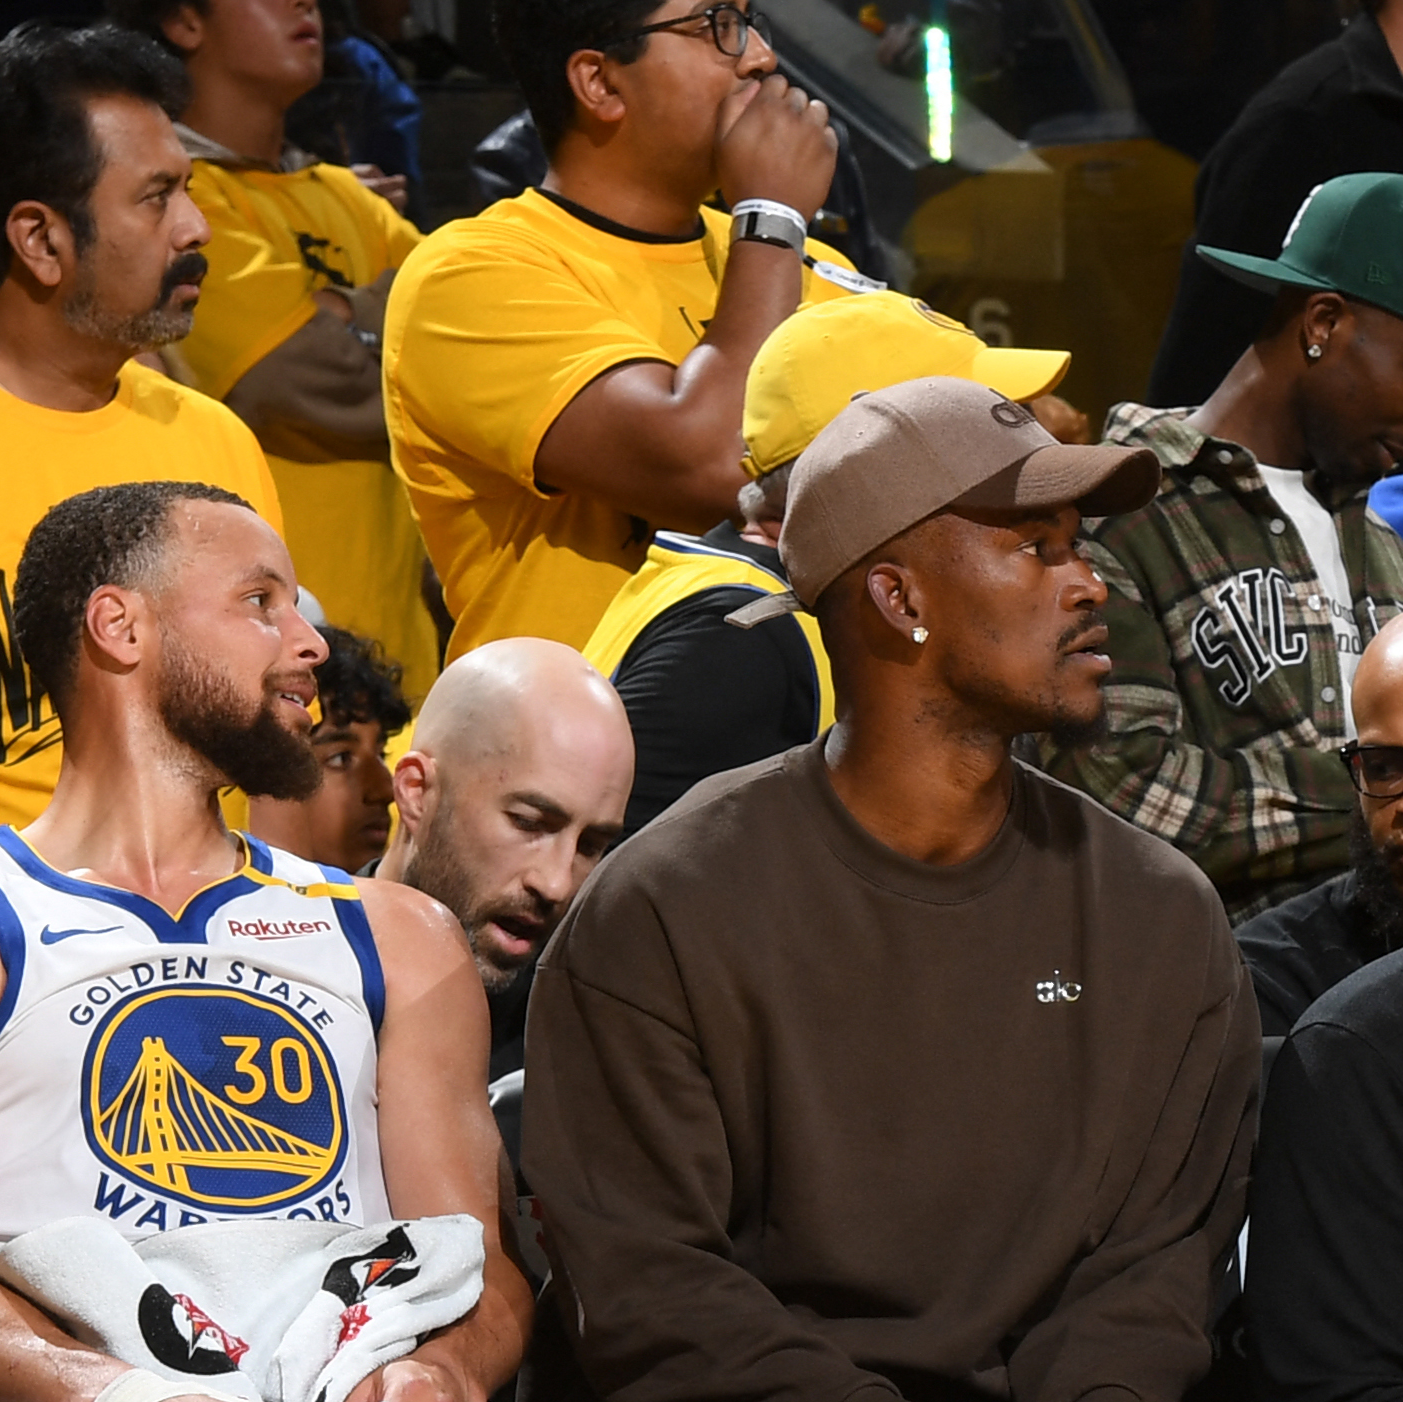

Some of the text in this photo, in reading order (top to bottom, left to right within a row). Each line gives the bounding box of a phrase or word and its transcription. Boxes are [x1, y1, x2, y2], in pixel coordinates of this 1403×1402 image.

[227, 919, 331, 940] Rakuten
[69, 957, 335, 1030] GOLDEN STATE
[220, 1036, 312, 1105] 30
